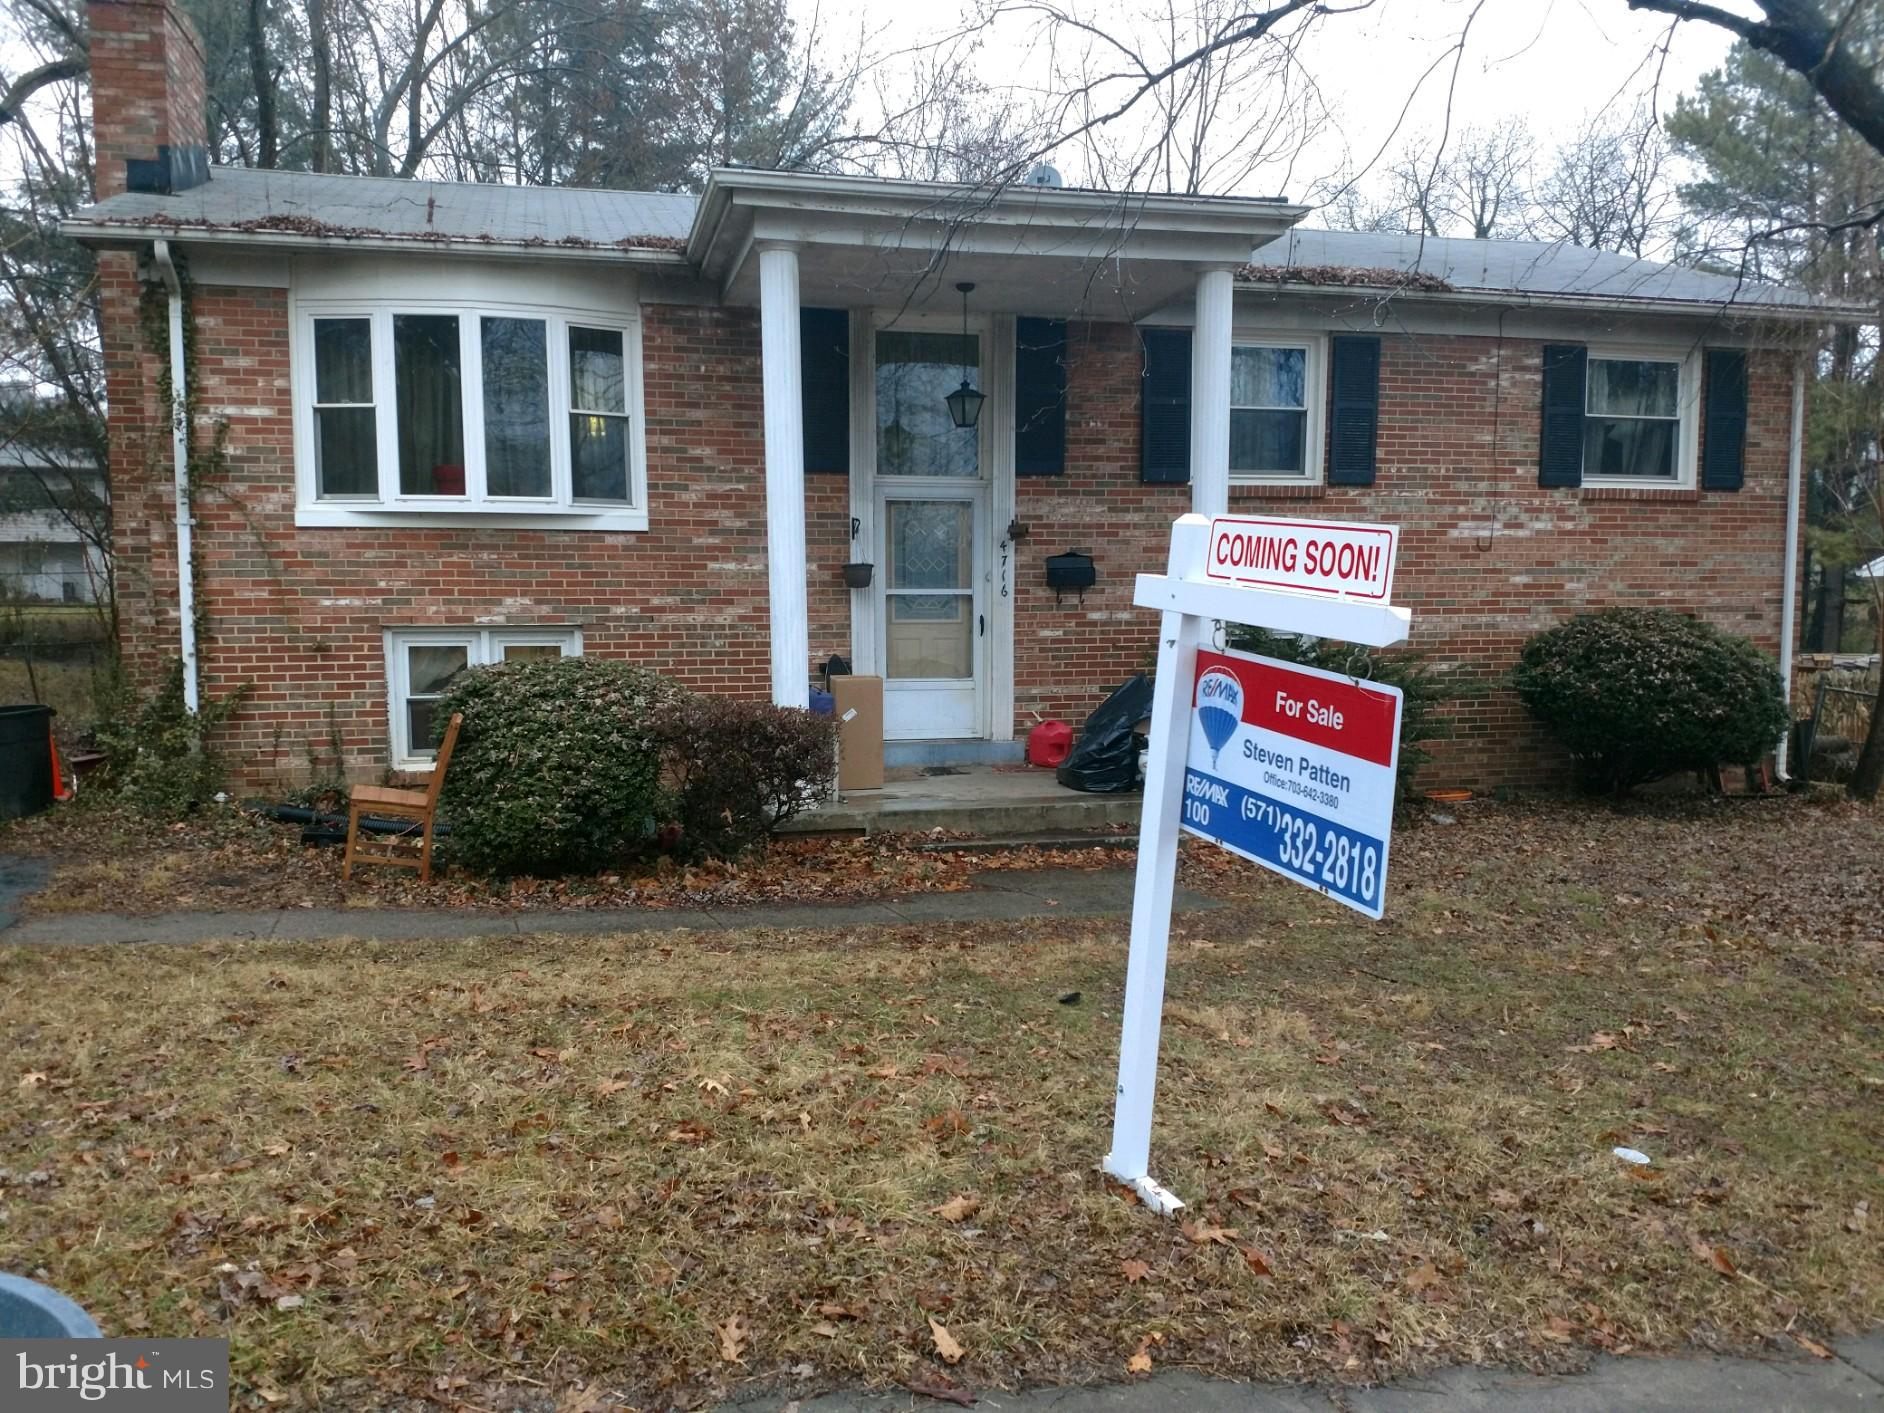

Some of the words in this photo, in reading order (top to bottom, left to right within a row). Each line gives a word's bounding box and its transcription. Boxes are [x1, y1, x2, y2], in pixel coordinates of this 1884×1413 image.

[999, 540, 1008, 598] 4716
[1216, 532, 1298, 572] COMING
[1303, 540, 1381, 582] SOON!
[1275, 691, 1301, 720] For
[1306, 698, 1344, 730] Sale
[1243, 739, 1294, 774] Steven
[1299, 756, 1350, 793] Patten
[1185, 798, 1209, 826] 100
